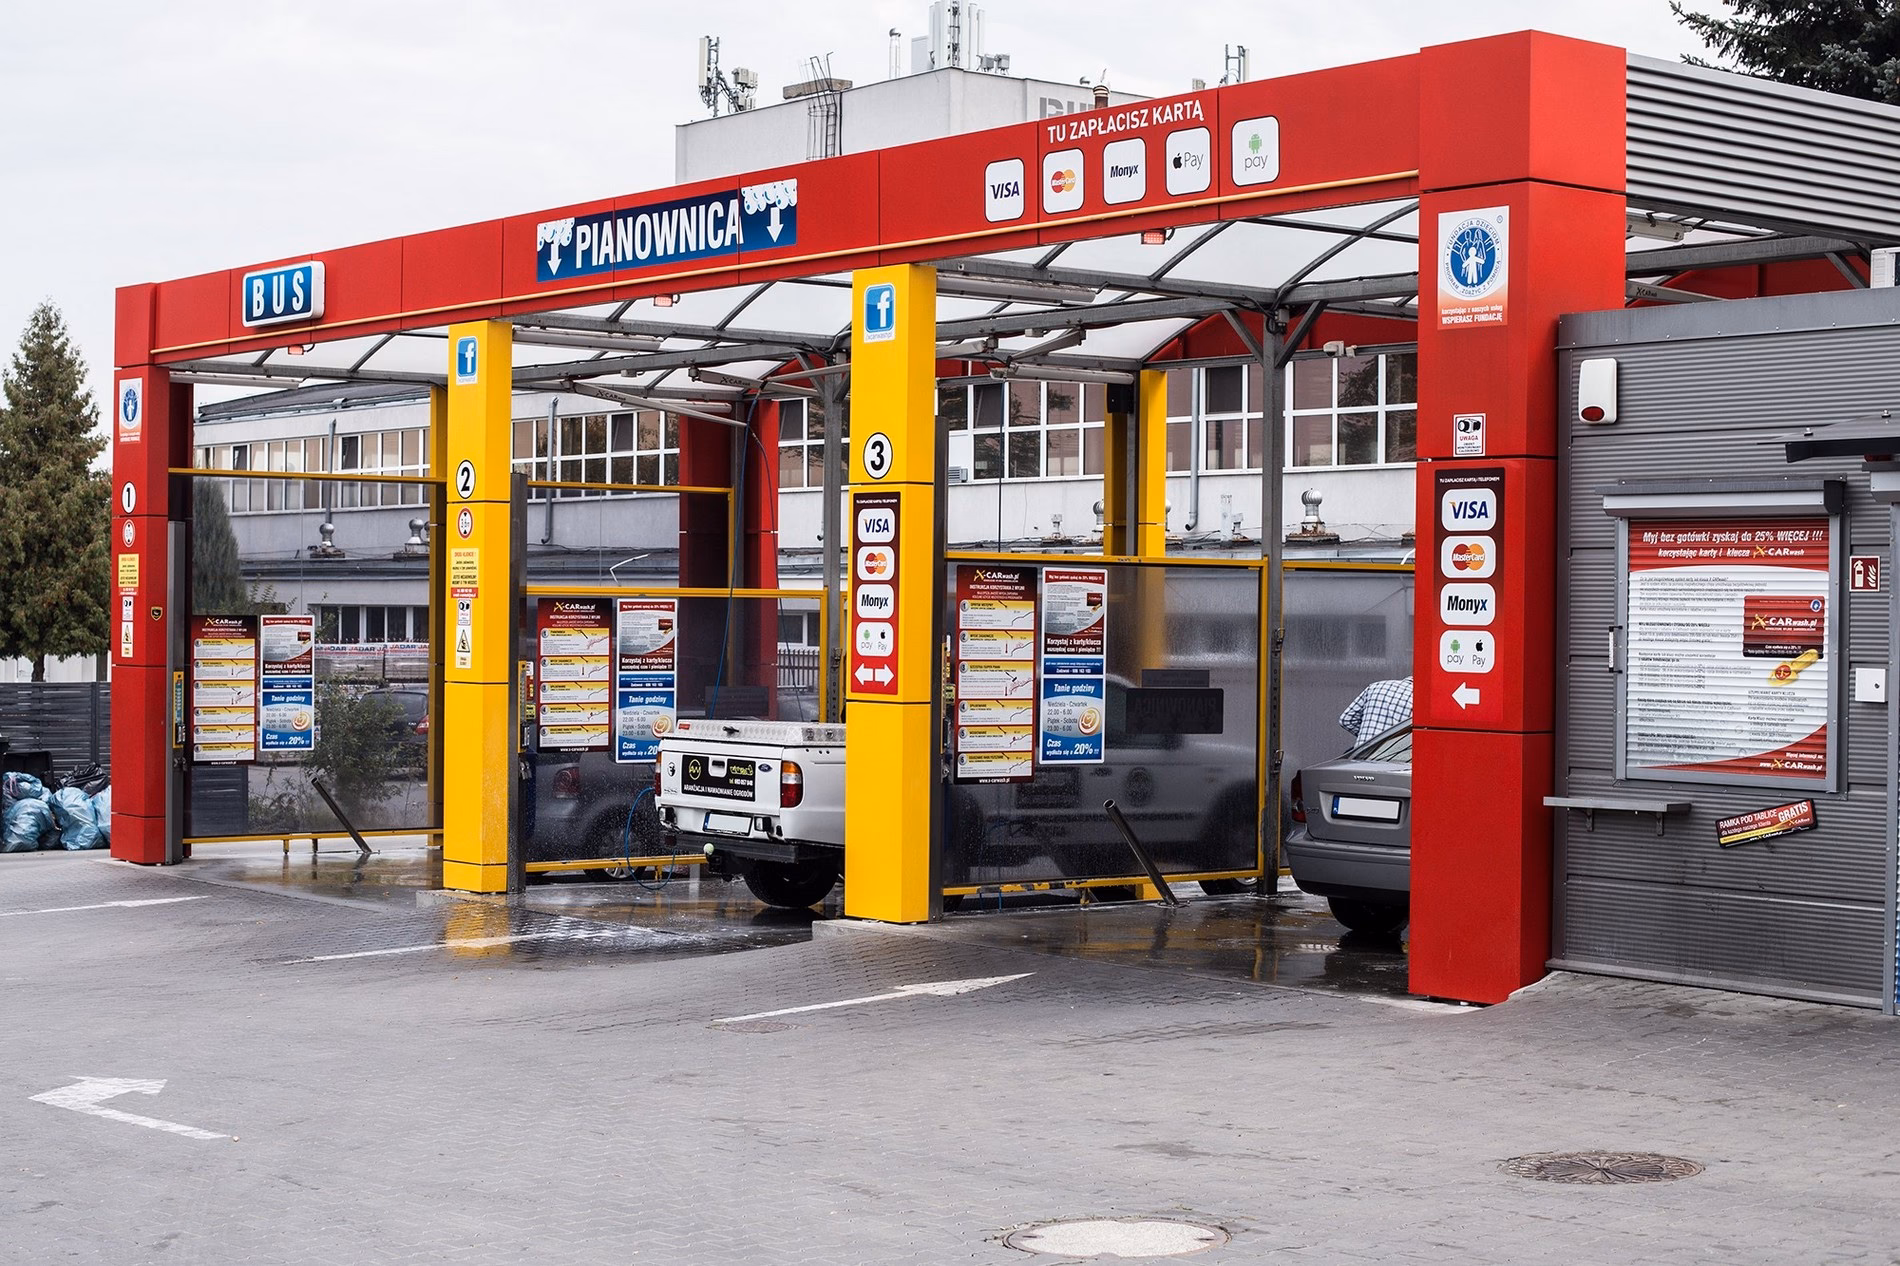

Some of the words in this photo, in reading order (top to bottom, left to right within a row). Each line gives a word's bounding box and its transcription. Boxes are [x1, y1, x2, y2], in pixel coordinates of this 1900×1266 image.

[1047, 123, 1066, 144] TU
[1069, 108, 1149, 140] ZAPŁACISZ
[1152, 99, 1205, 125] KARTĄ
[1184, 151, 1204, 171] Pay
[1244, 153, 1268, 172] pay
[1110, 163, 1139, 179] Monyx
[990, 181, 1020, 200] VISA
[575, 198, 744, 269] PIANOWNICA
[252, 270, 304, 317] BUS
[870, 440, 885, 471] 3
[461, 466, 471, 492] 2
[126, 488, 131, 508] 1
[1449, 500, 1489, 520] VISA
[863, 518, 890, 533] VISA
[1643, 531, 1659, 545] Myj
[1660, 531, 1675, 542] bez
[1676, 531, 1711, 545] gotówki
[1712, 531, 1739, 545] zyskaj
[1741, 531, 1752, 542] do
[1754, 530, 1774, 542] 25%
[1776, 530, 1809, 544] WIĘCEJ
[1812, 530, 1824, 541] !!!
[1452, 553, 1486, 562] MasterCard
[1658, 548, 1697, 559] korzystając
[1698, 548, 1718, 559] karty
[1726, 548, 1751, 558] klucza
[861, 594, 889, 610] Monyx
[1447, 595, 1488, 615] Monyx
[1751, 613, 1818, 630] X-CARwash.pl
[1047, 638, 1069, 646] Korzystaj
[1446, 654, 1465, 665] pay
[1472, 653, 1486, 668] Pay
[1054, 683, 1071, 693] Tanie
[1071, 683, 1095, 694] godziny
[628, 695, 644, 703] Tanie
[645, 695, 667, 704] godziny
[288, 736, 305, 745] 20%
[622, 741, 636, 749] Czas
[1047, 738, 1062, 748] Czas
[1073, 743, 1094, 755] 20%
[733, 788, 753, 798] OGRODÓW
[1719, 818, 1740, 829] RAMKA
[1740, 815, 1753, 825] POD
[1753, 809, 1778, 822] TABLICE
[1778, 801, 1809, 823] GRATIS
